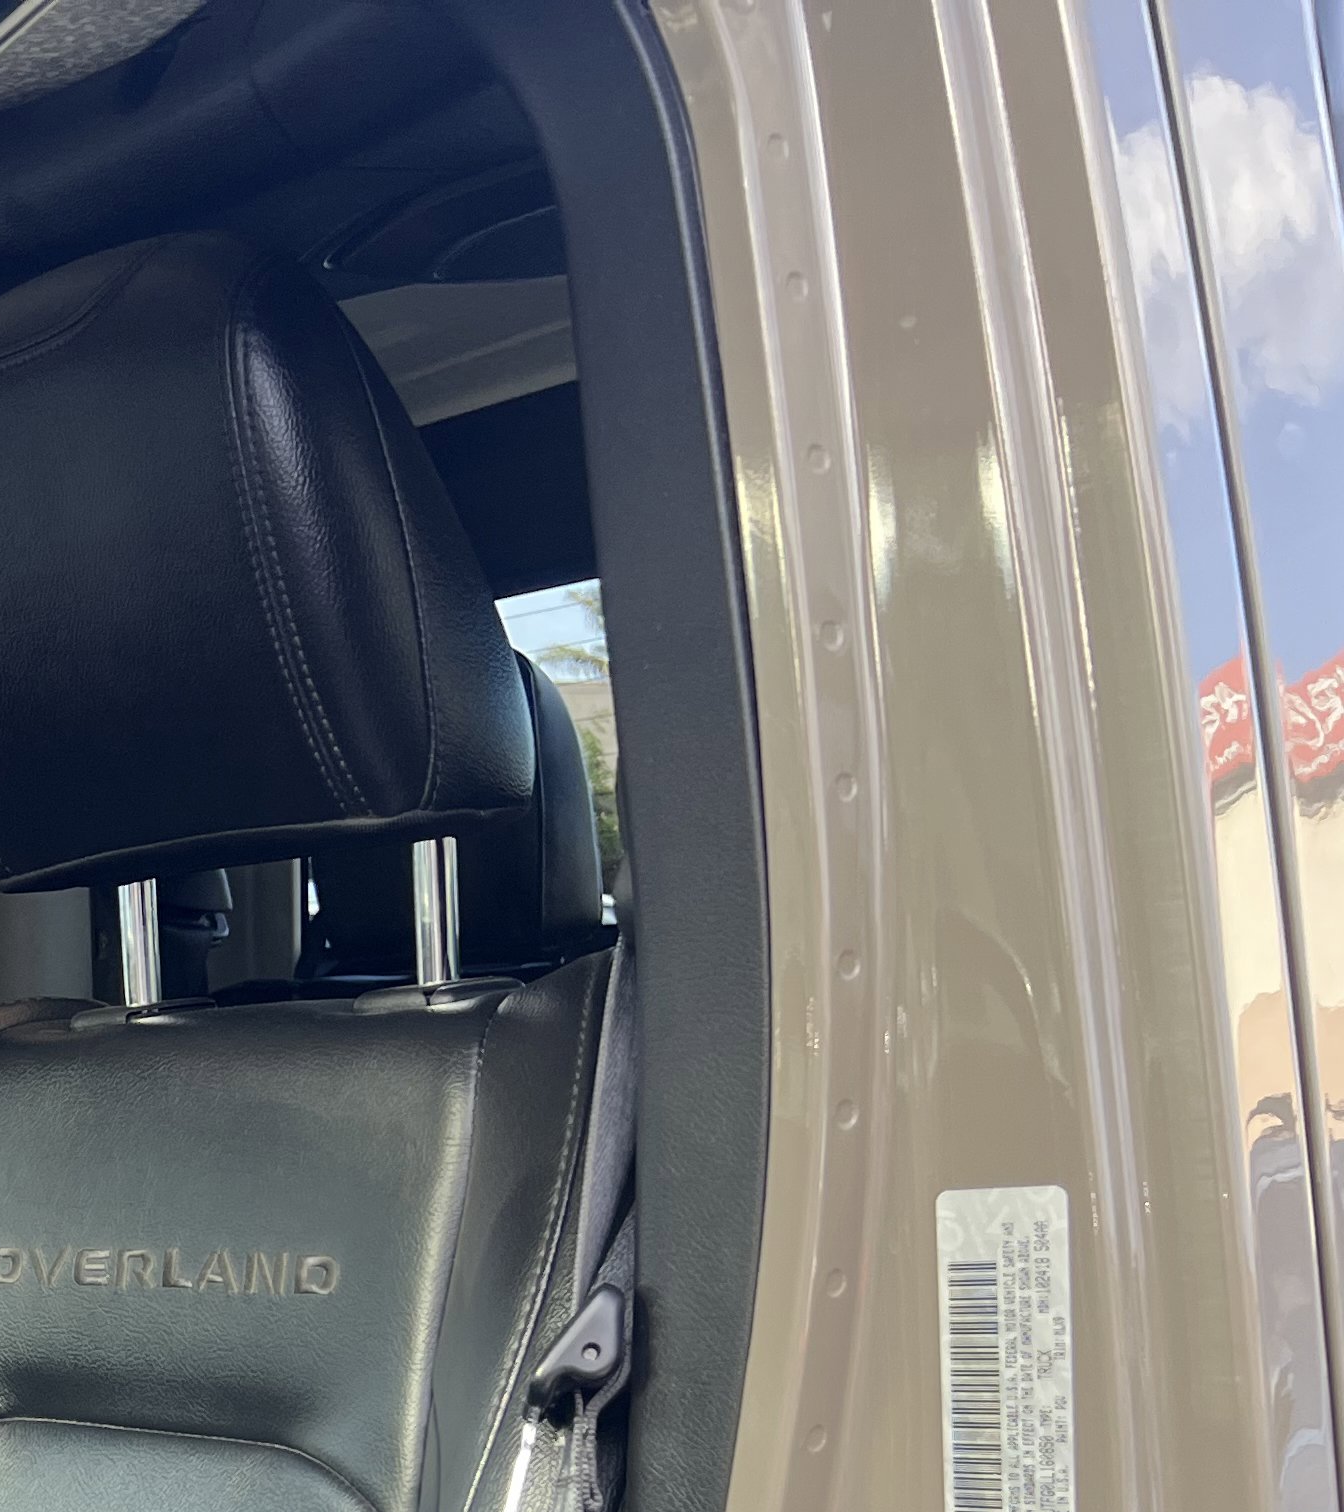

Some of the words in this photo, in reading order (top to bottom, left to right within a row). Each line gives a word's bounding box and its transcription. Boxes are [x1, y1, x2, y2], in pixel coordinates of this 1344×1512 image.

[1003, 1272, 1016, 1304] VEHICLE
[1037, 1349, 1053, 1380] TRUCK
[1021, 1418, 1034, 1446] EFFECT
